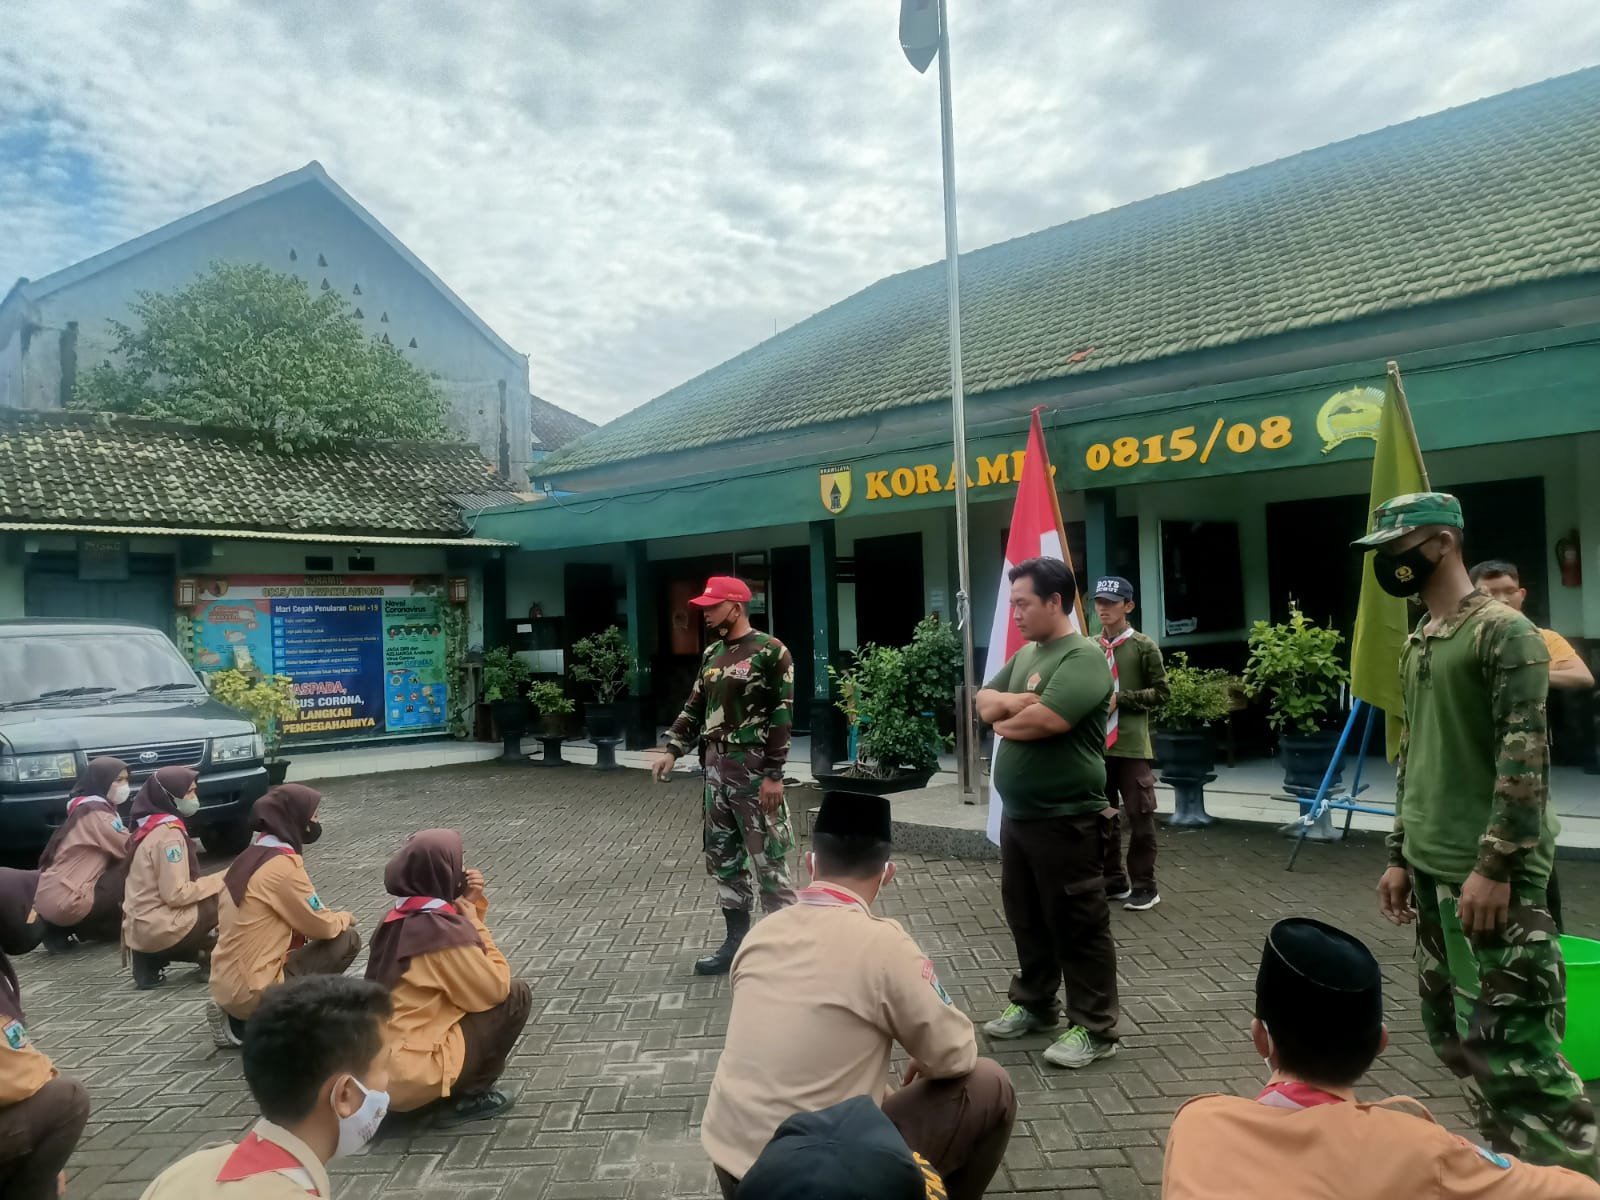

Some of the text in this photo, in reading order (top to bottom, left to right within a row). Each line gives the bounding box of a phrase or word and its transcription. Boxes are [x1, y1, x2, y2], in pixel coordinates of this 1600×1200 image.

[865, 450, 1056, 500] KORAMI
[1086, 416, 1292, 472] 0815/08
[820, 465, 850, 475] BRAWIJAYA
[1097, 580, 1120, 589] BOYS
[275, 605, 291, 613] Mari
[292, 604, 313, 614] Cegah
[314, 604, 347, 612] Penularan
[385, 605, 426, 613] Coronavirus
[318, 695, 365, 707] CORONA,
[300, 707, 352, 720] LANGKAH
[282, 717, 376, 734] PENCEGAHANNYA
